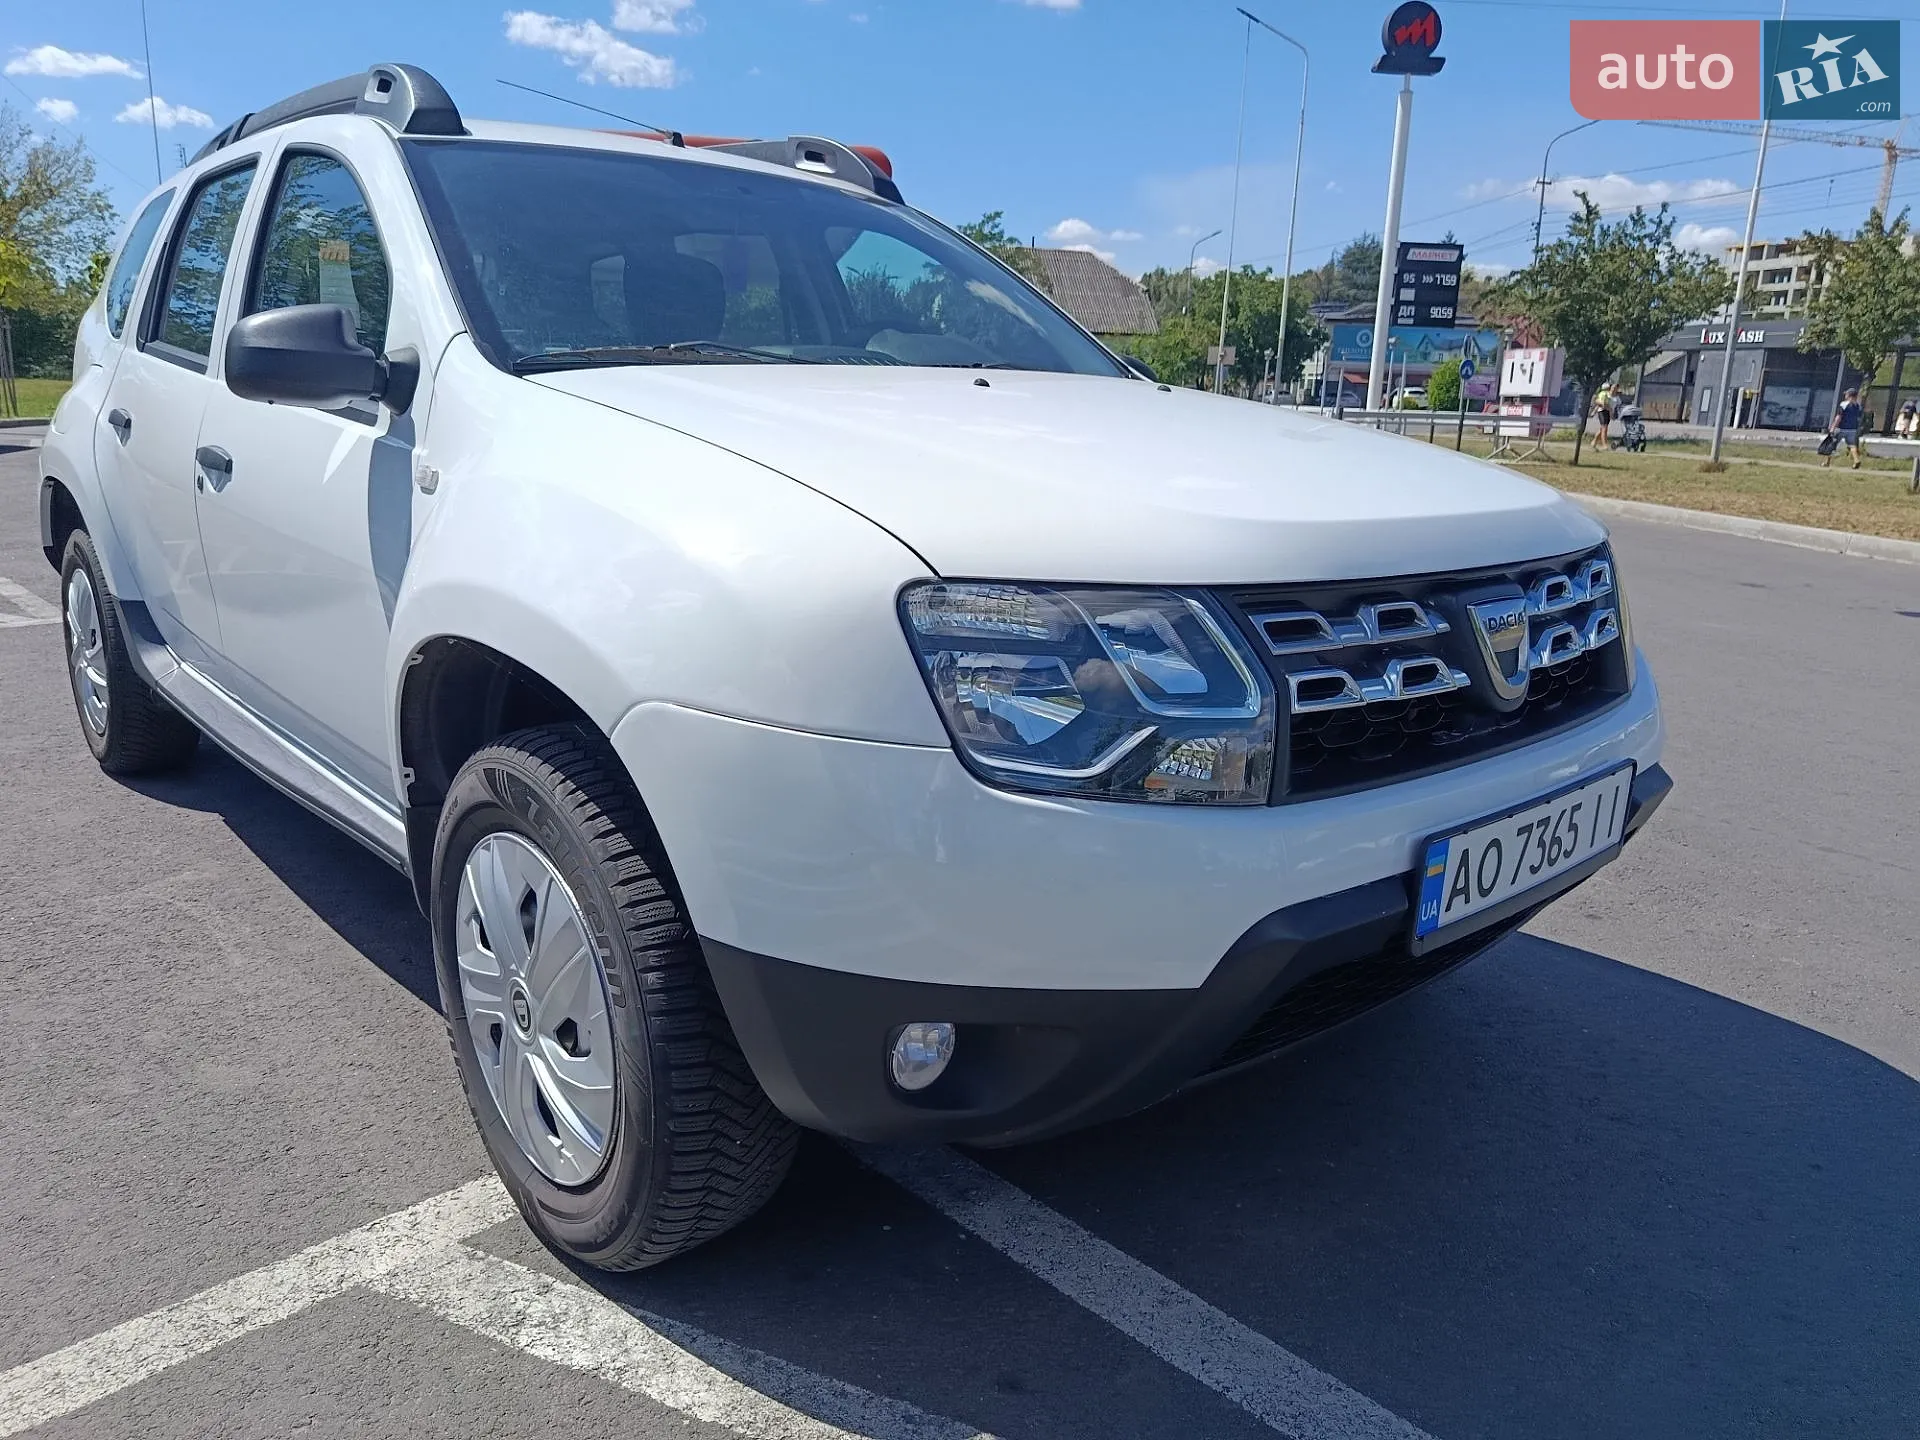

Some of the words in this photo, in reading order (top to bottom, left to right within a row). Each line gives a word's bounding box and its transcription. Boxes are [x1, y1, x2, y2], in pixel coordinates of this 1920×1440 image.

[1411, 250, 1457, 260] МАРКЕТ
[1403, 272, 1416, 283] 95
[1398, 305, 1415, 317] ДП
[1735, 327, 1765, 343] ASH
[1487, 611, 1526, 631] DACIA
[1445, 837, 1503, 913] AO
[1510, 802, 1583, 886] 7365
[1590, 785, 1620, 848] II
[1421, 899, 1439, 921] UA
